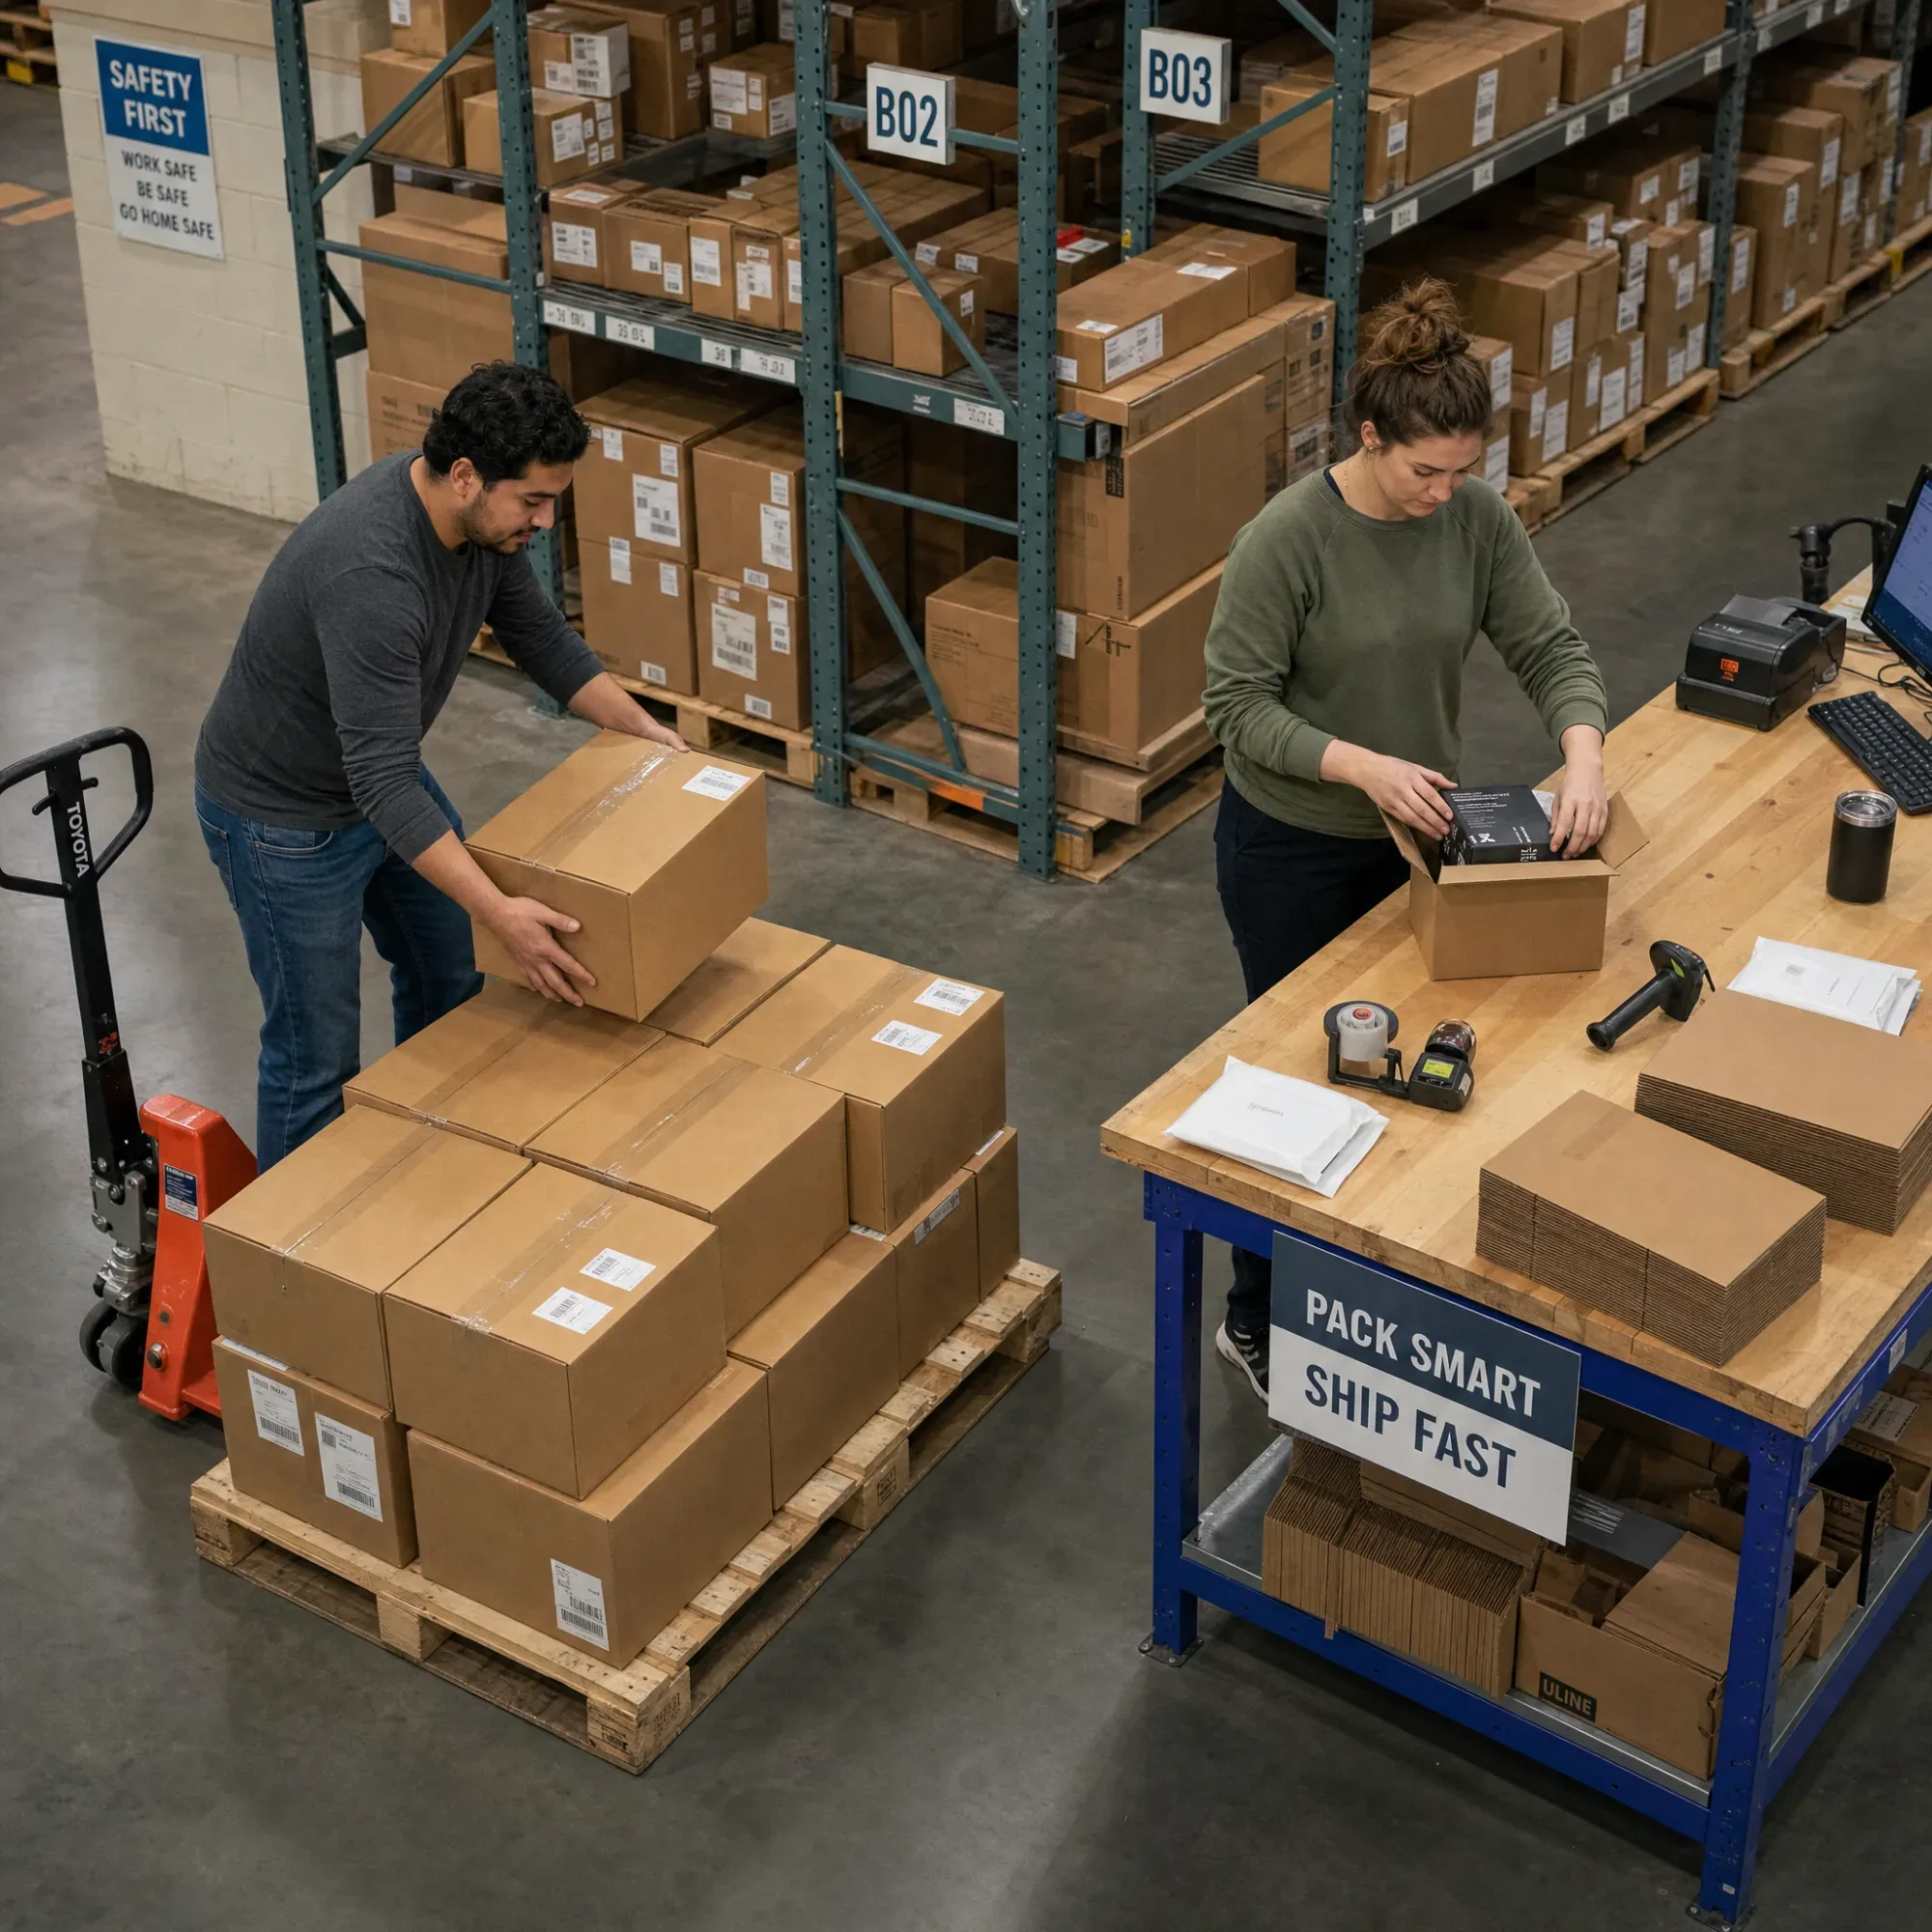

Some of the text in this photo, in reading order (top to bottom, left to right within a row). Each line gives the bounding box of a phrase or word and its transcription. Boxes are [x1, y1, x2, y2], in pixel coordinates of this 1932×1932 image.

[109, 59, 192, 101] SAFETY
[1149, 48, 1211, 107] B03
[124, 99, 186, 138] FIRST
[876, 85, 938, 148] B02
[121, 150, 197, 182] WORK SAFE
[136, 180, 189, 207] BE SAFE
[120, 203, 214, 241] GO HOME SAFE
[67, 801, 90, 878] TOYOTA
[1306, 1289, 1541, 1417] PACK SMART
[1305, 1364, 1517, 1488] SHIP FAST
[1543, 1678, 1592, 1717] ULINE
